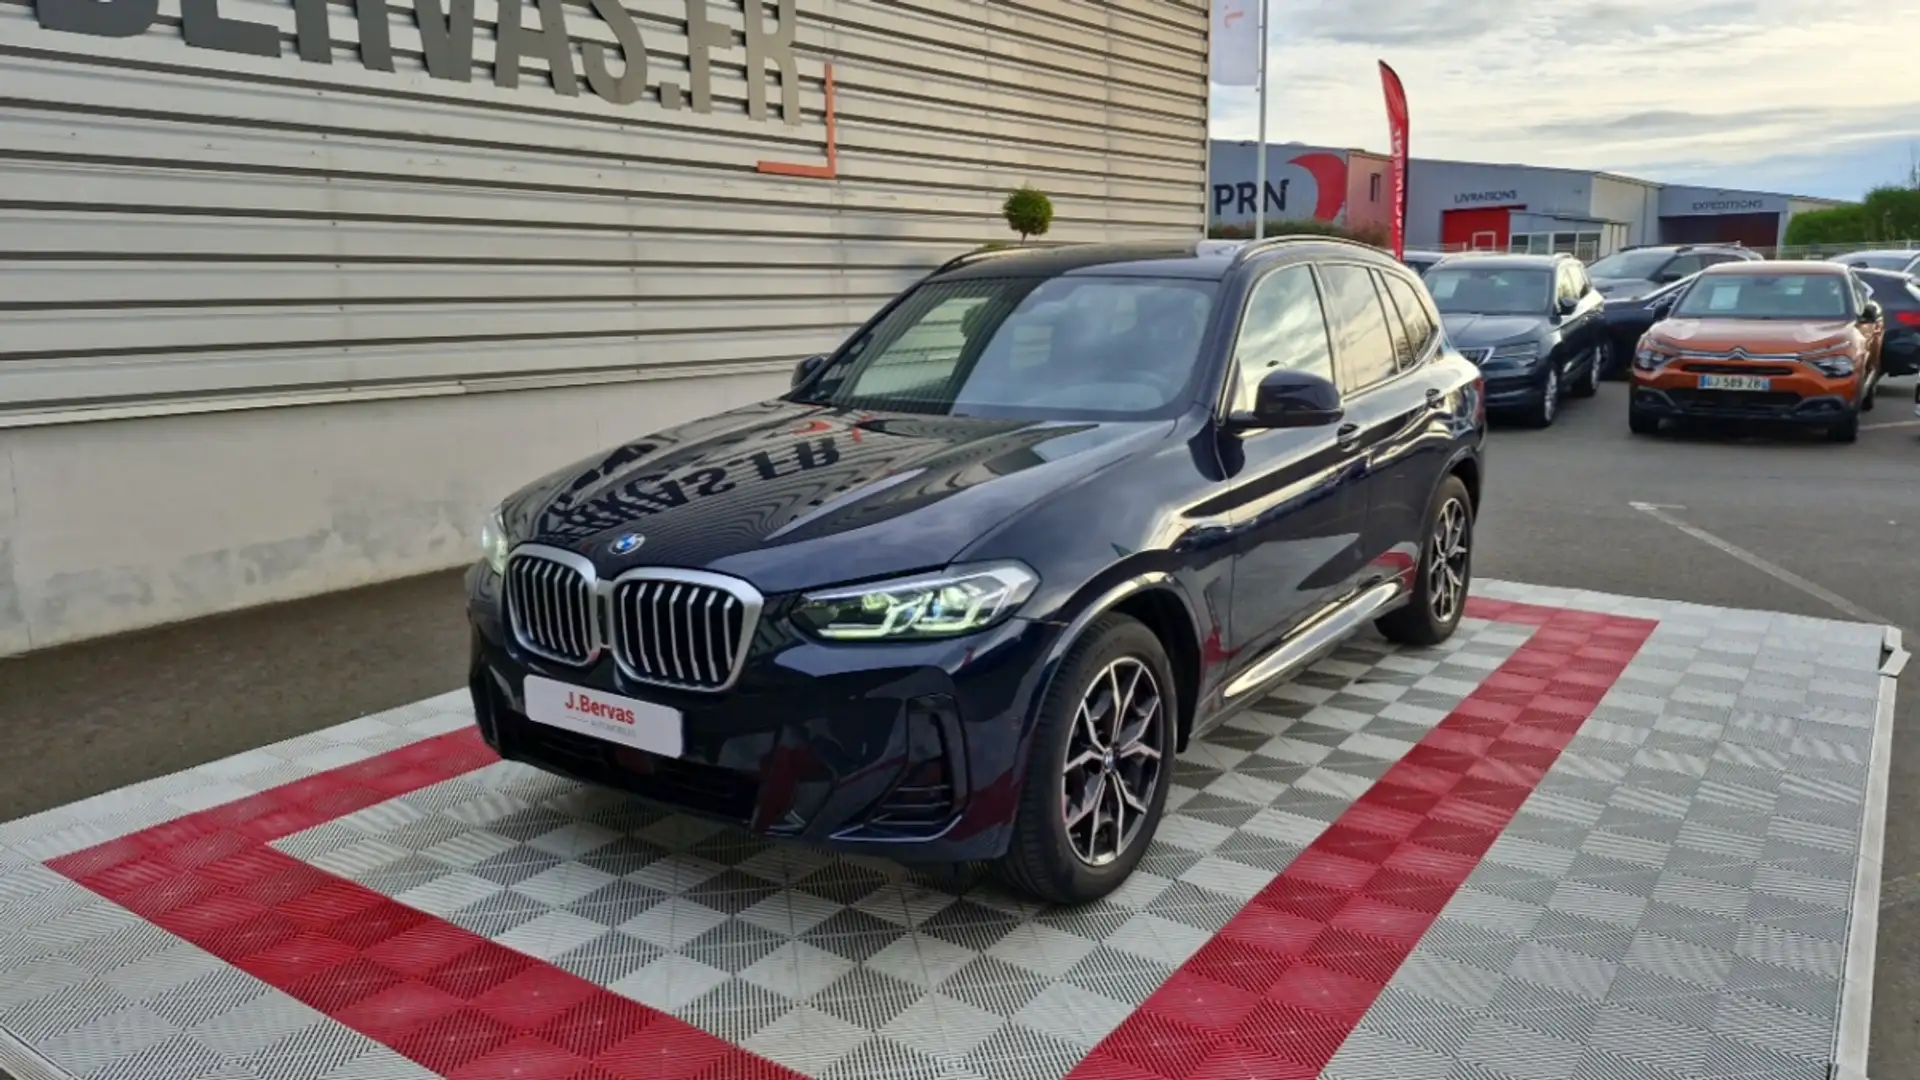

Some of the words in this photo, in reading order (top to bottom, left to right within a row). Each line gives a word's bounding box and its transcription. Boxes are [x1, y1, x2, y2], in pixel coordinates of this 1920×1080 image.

[36, 0, 801, 126] AS.FR
[1213, 179, 1290, 215] PRN
[1454, 190, 1518, 204] LIVRAISONS
[565, 692, 636, 725] J.Bervas
